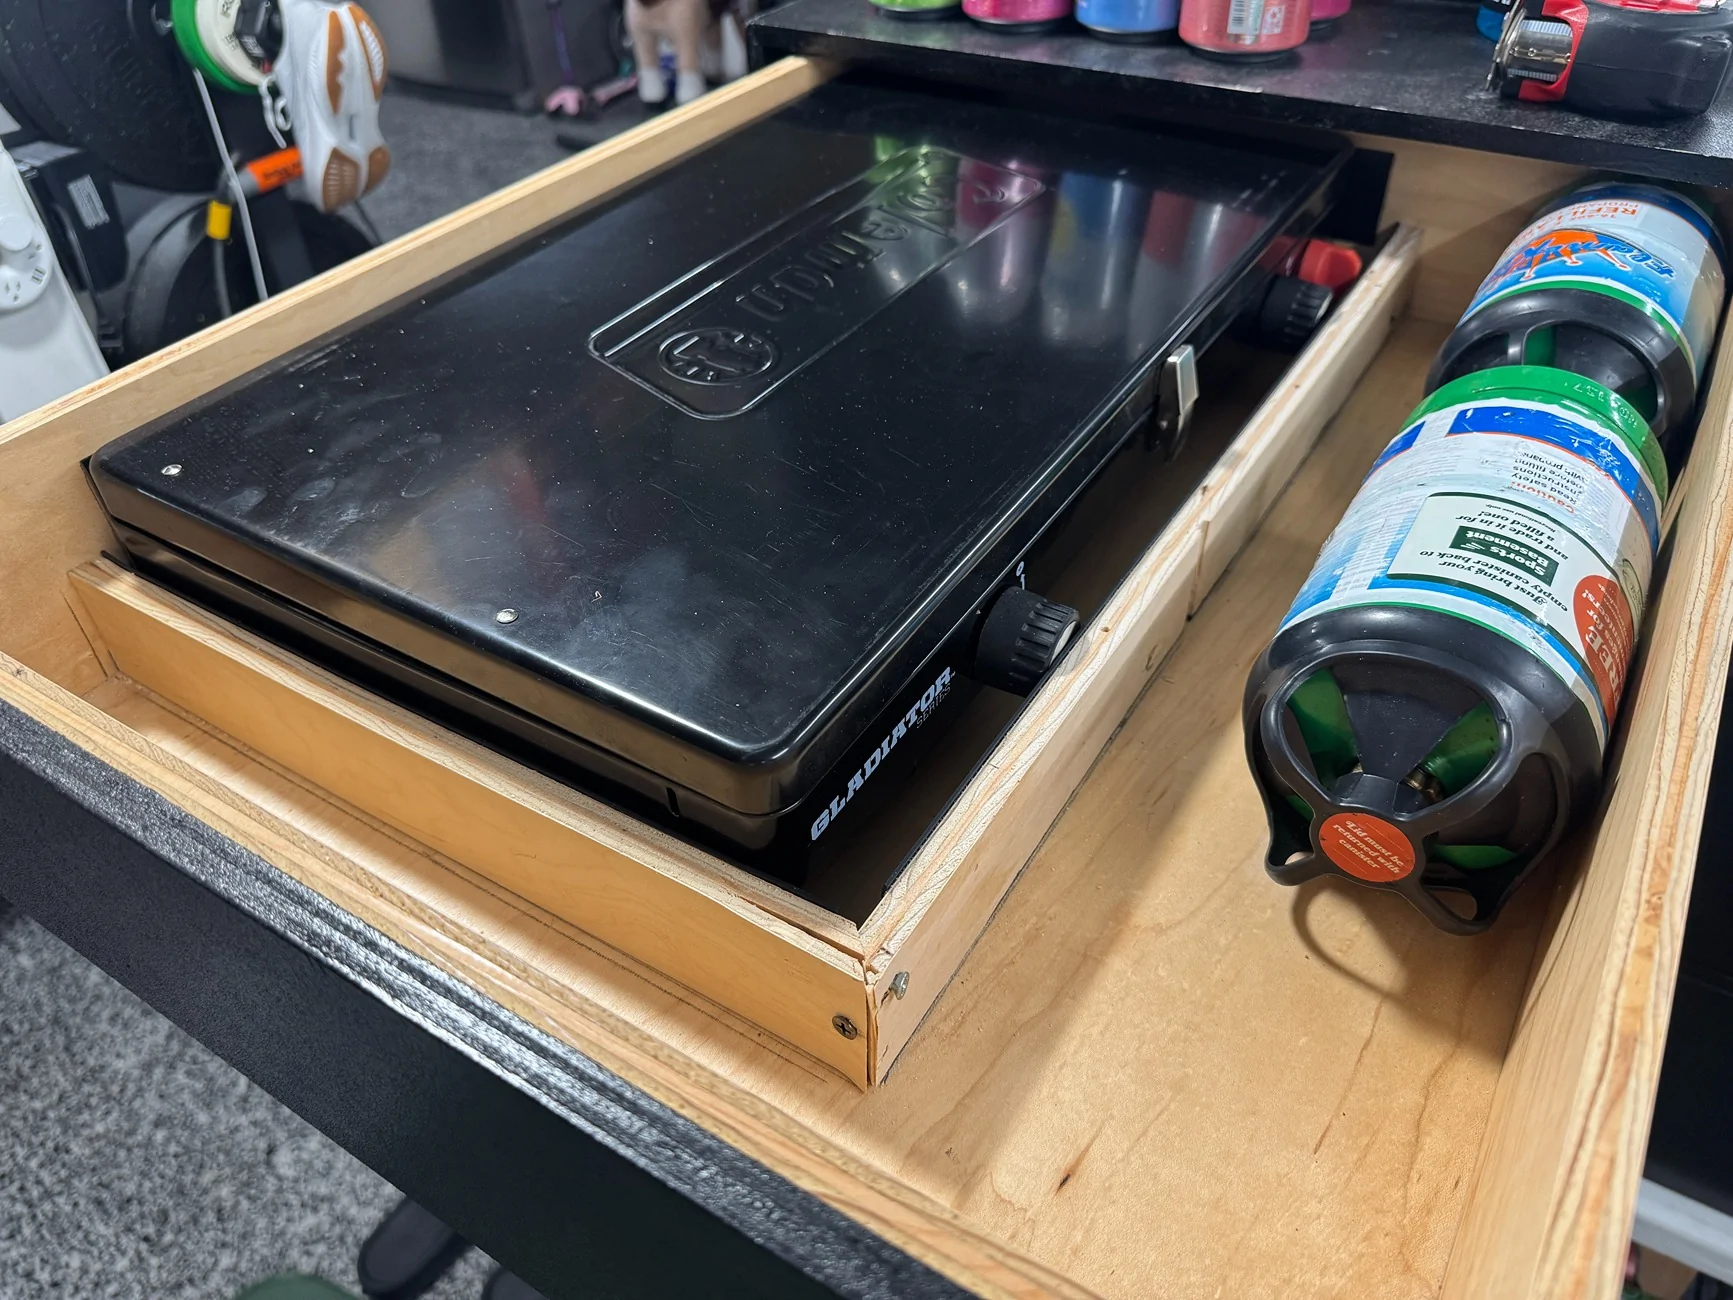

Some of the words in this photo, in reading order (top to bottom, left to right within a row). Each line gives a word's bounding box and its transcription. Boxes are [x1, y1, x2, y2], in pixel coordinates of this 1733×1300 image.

[1511, 472, 1548, 488] safety
[1550, 487, 1577, 505] Read
[1455, 515, 1477, 523] for
[1477, 510, 1509, 522] one!
[1495, 522, 1507, 530] it
[1508, 526, 1543, 545] trade
[1509, 519, 1545, 537] filled
[1436, 551, 1473, 563] back
[1465, 530, 1549, 567] Basement
[1544, 544, 1569, 560] and
[1438, 560, 1475, 572] your
[1489, 546, 1546, 576] Sports
[1473, 559, 1529, 584] canister
[1474, 568, 1513, 588] bring
[1514, 582, 1547, 605] Just
[1530, 584, 1568, 612] empty
[1586, 609, 1604, 630] for
[916, 682, 951, 729] SERIES
[811, 666, 951, 841] GLADIATOR
[1332, 824, 1380, 857] returned
[1377, 856, 1400, 874] with
[1345, 820, 1368, 837] Lid
[1363, 836, 1392, 856] must
[1389, 855, 1404, 866] be
[1339, 839, 1380, 869] canister
